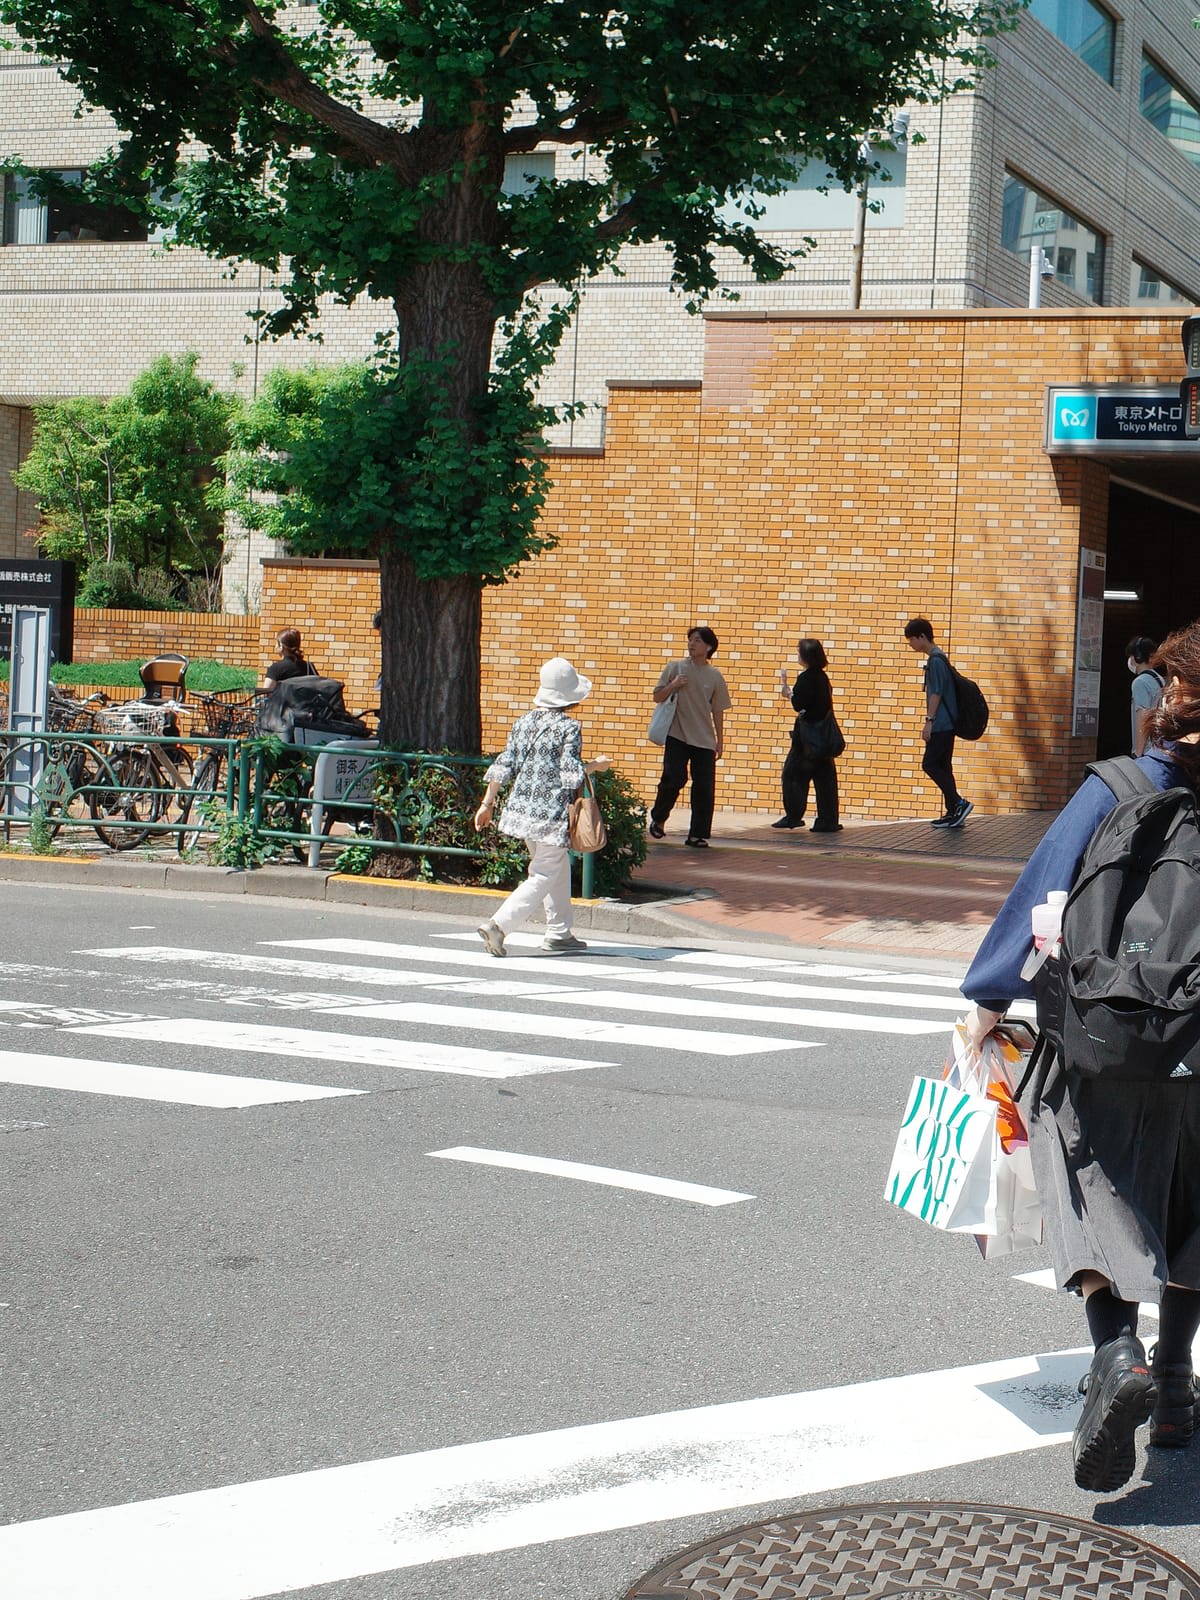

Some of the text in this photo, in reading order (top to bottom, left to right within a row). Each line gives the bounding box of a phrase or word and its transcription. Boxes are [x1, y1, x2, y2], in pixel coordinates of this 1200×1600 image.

[1114, 406, 1183, 420] 東京メトロ
[1118, 422, 1178, 433] Tokyo Metro
